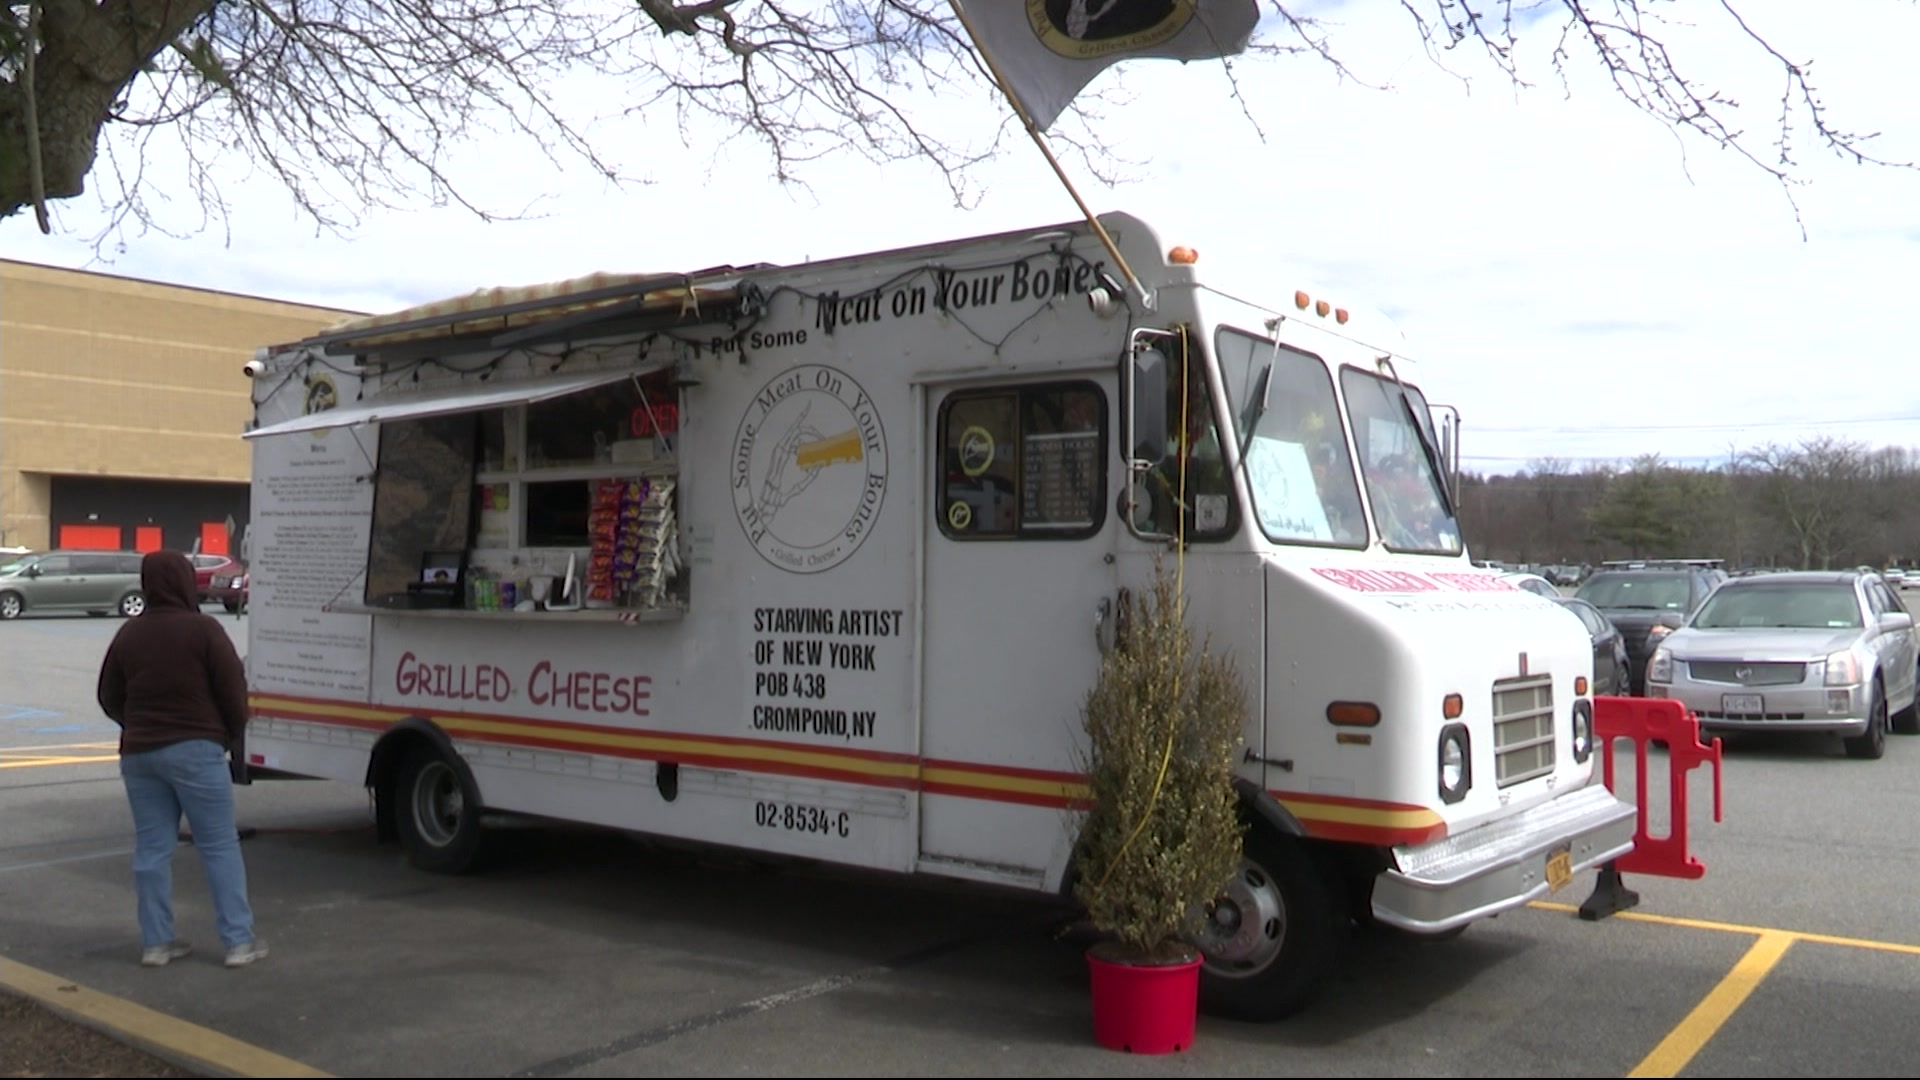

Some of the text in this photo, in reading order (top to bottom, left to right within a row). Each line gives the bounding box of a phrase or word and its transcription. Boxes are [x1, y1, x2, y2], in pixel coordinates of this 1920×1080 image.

[711, 260, 1105, 354] Put Some Meat on Your Bones
[735, 369, 884, 545] Put Some Meat On Your Bones
[754, 607, 903, 637] STARVING ARTIST
[755, 640, 876, 671] OF NEW YORK
[396, 651, 652, 716] GRILLED CHEESE
[756, 672, 826, 699] POB 438
